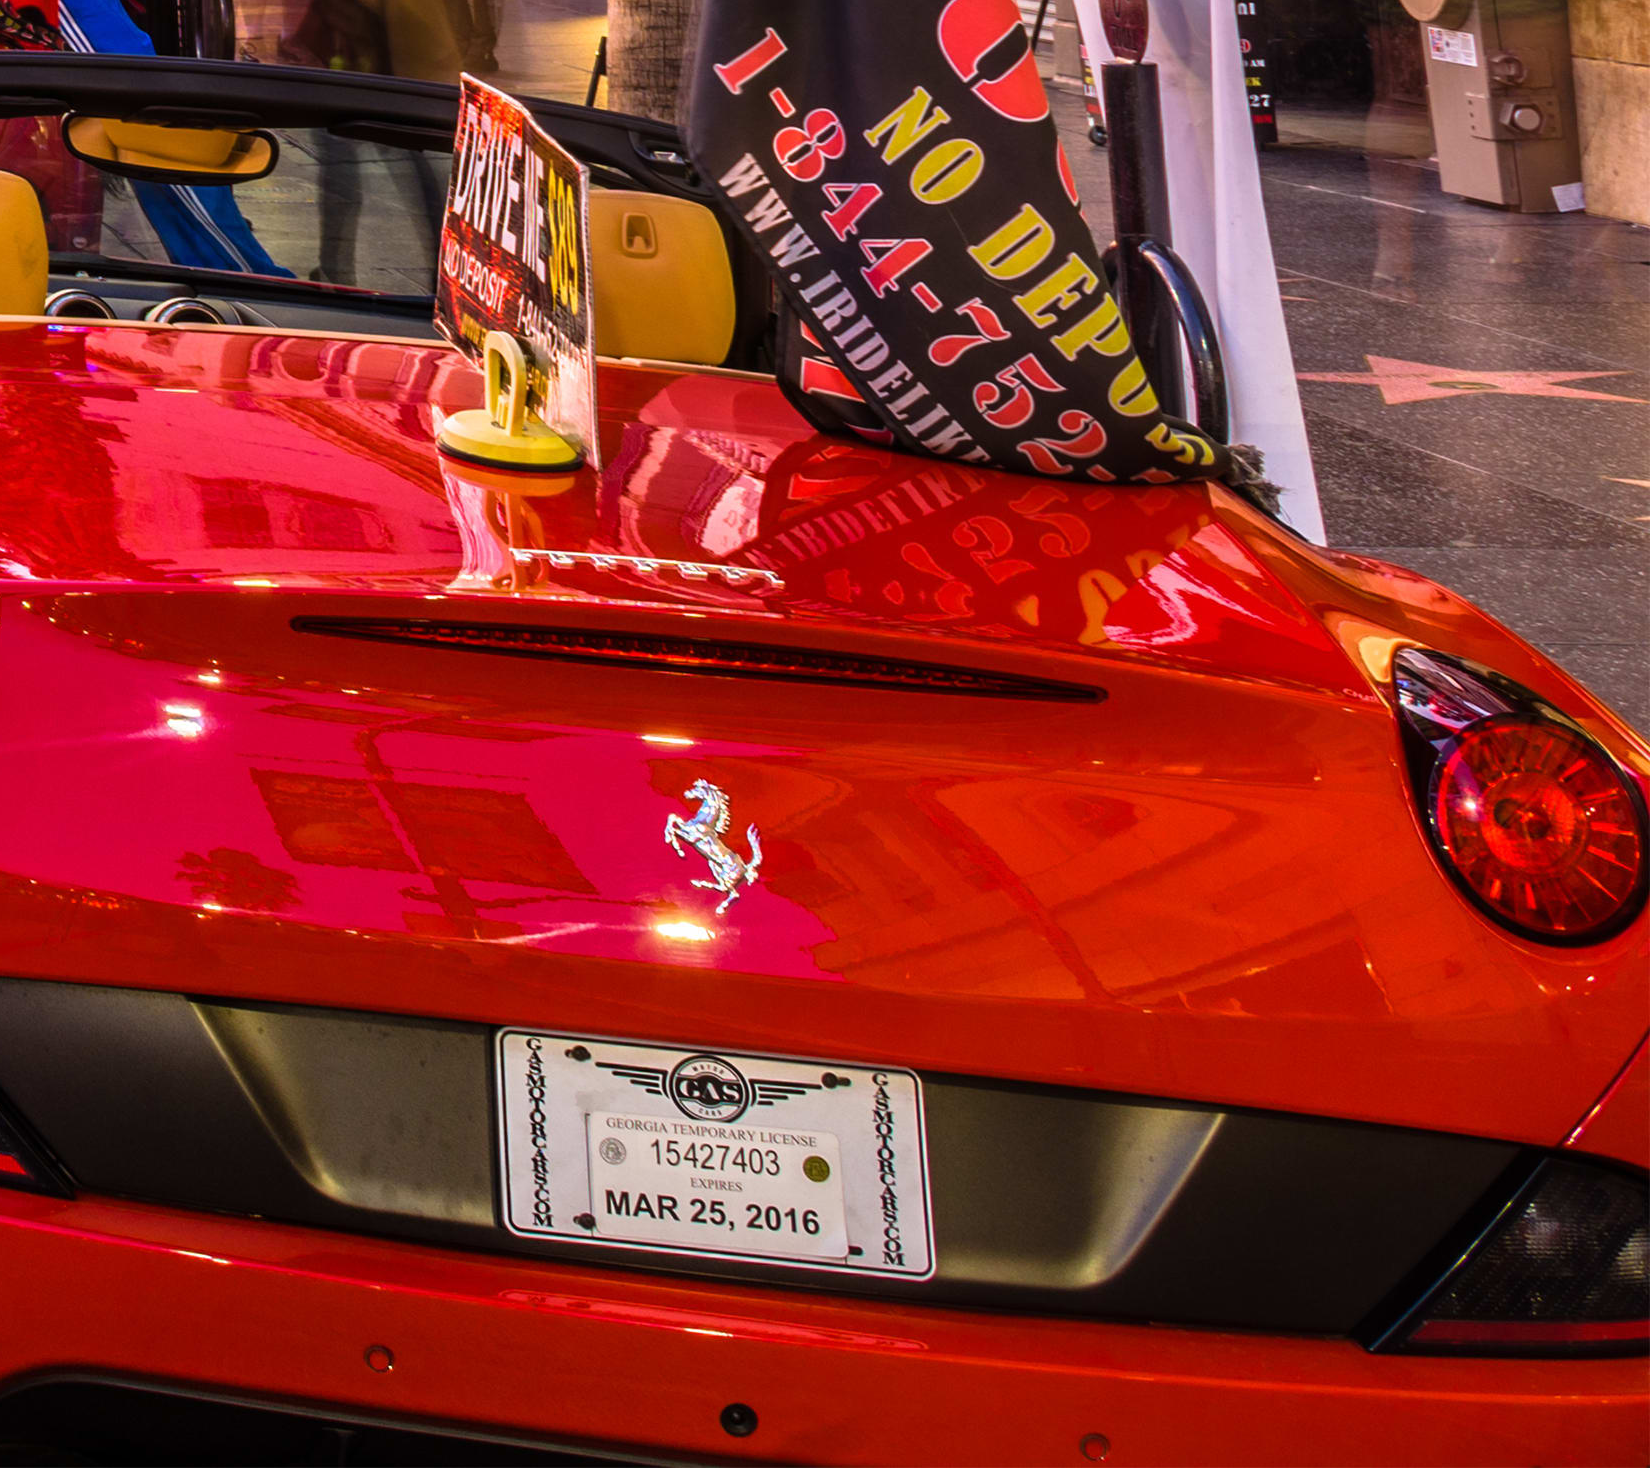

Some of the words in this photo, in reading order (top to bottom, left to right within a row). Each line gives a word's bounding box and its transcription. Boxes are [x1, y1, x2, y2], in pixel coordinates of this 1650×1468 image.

[862, 84, 986, 205] NO
[453, 102, 522, 257] DRIVE
[522, 143, 547, 284] ME
[443, 242, 460, 280] NO
[459, 251, 509, 314] DEPOSIT
[691, 1063, 726, 1076] MOTOR
[677, 1073, 742, 1104] GAS
[697, 1106, 724, 1119] CARS
[606, 1116, 669, 1134] GEORGIA
[672, 1122, 757, 1143] TEMPORARY
[759, 1130, 817, 1149] LICENSE
[649, 1138, 781, 1177] 15427403
[689, 1176, 744, 1193] EXPIRES
[604, 1188, 680, 1221] MAR
[689, 1197, 736, 1231] 25,
[746, 1203, 821, 1235] 2016
